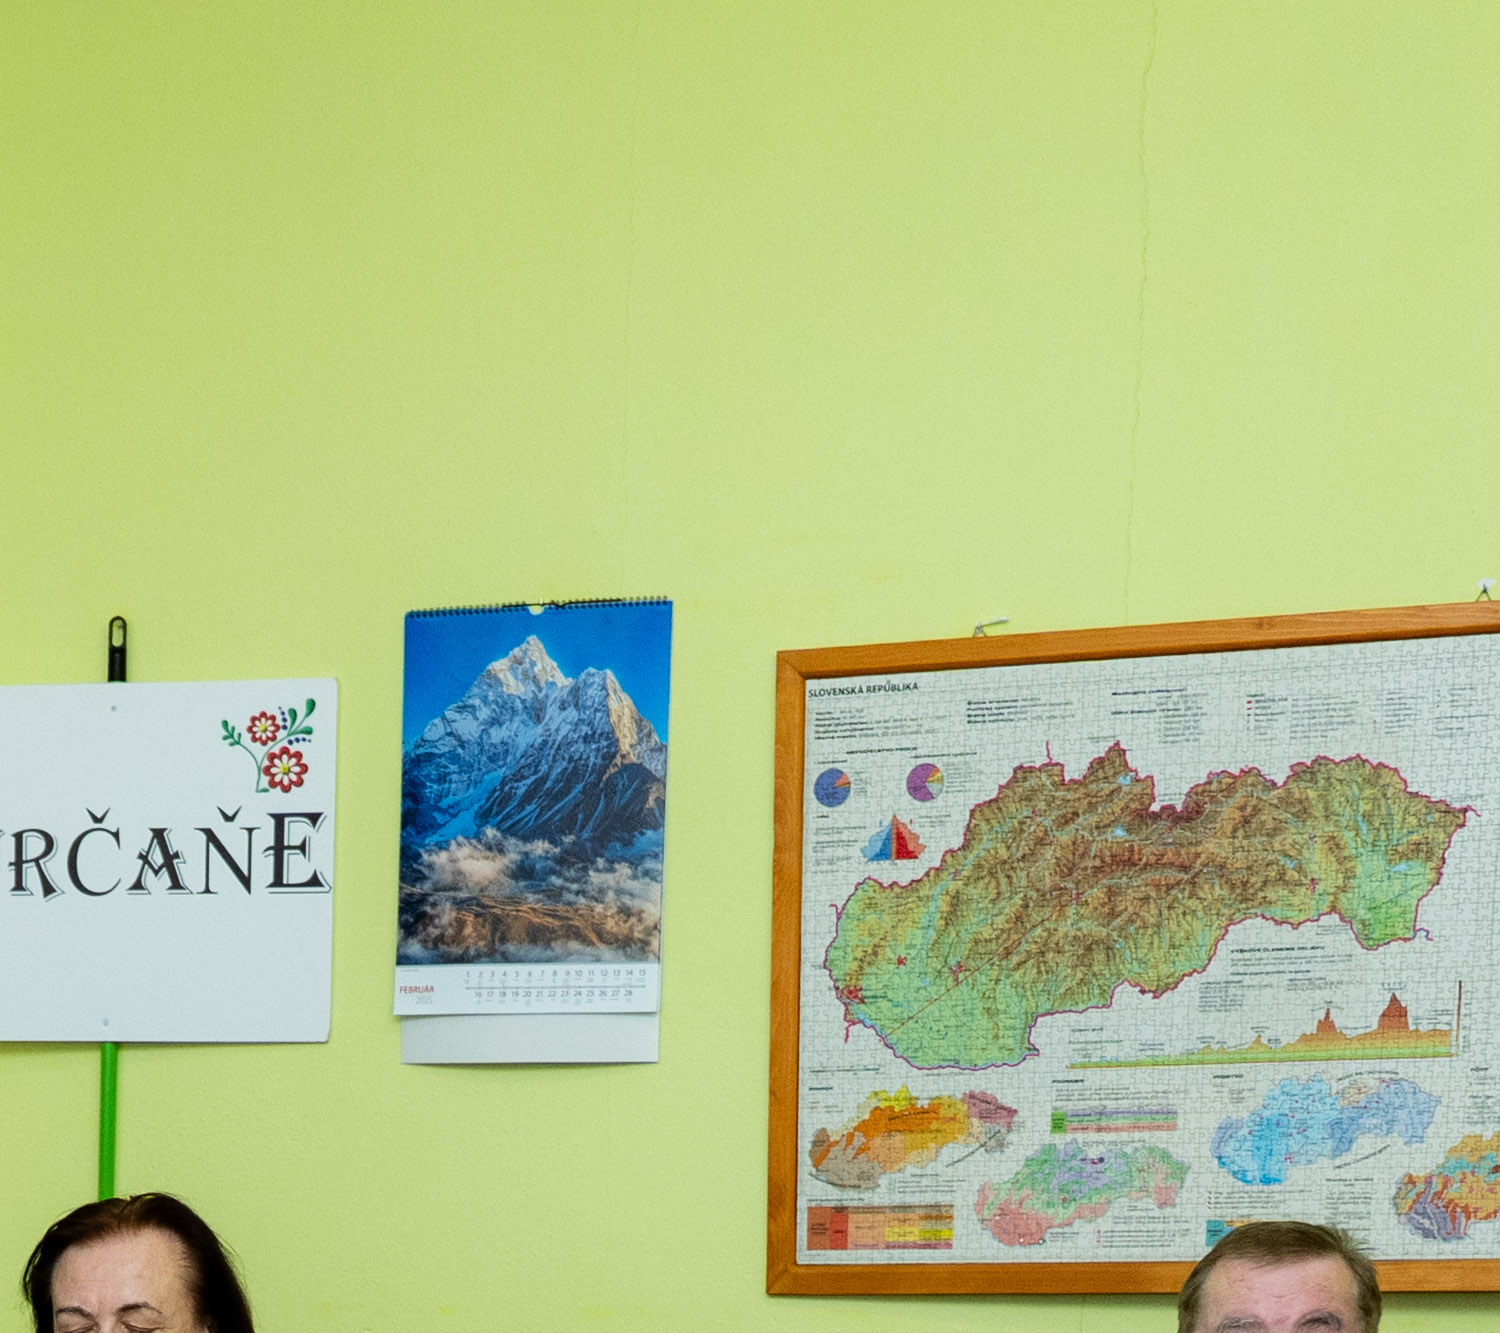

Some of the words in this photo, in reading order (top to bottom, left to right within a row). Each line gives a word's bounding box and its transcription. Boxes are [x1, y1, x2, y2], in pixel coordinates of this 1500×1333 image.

[808, 686, 864, 698] SLOVENSKÁ
[865, 682, 919, 694] REPUBLIKA
[399, 984, 435, 995] FEBRUÁR
